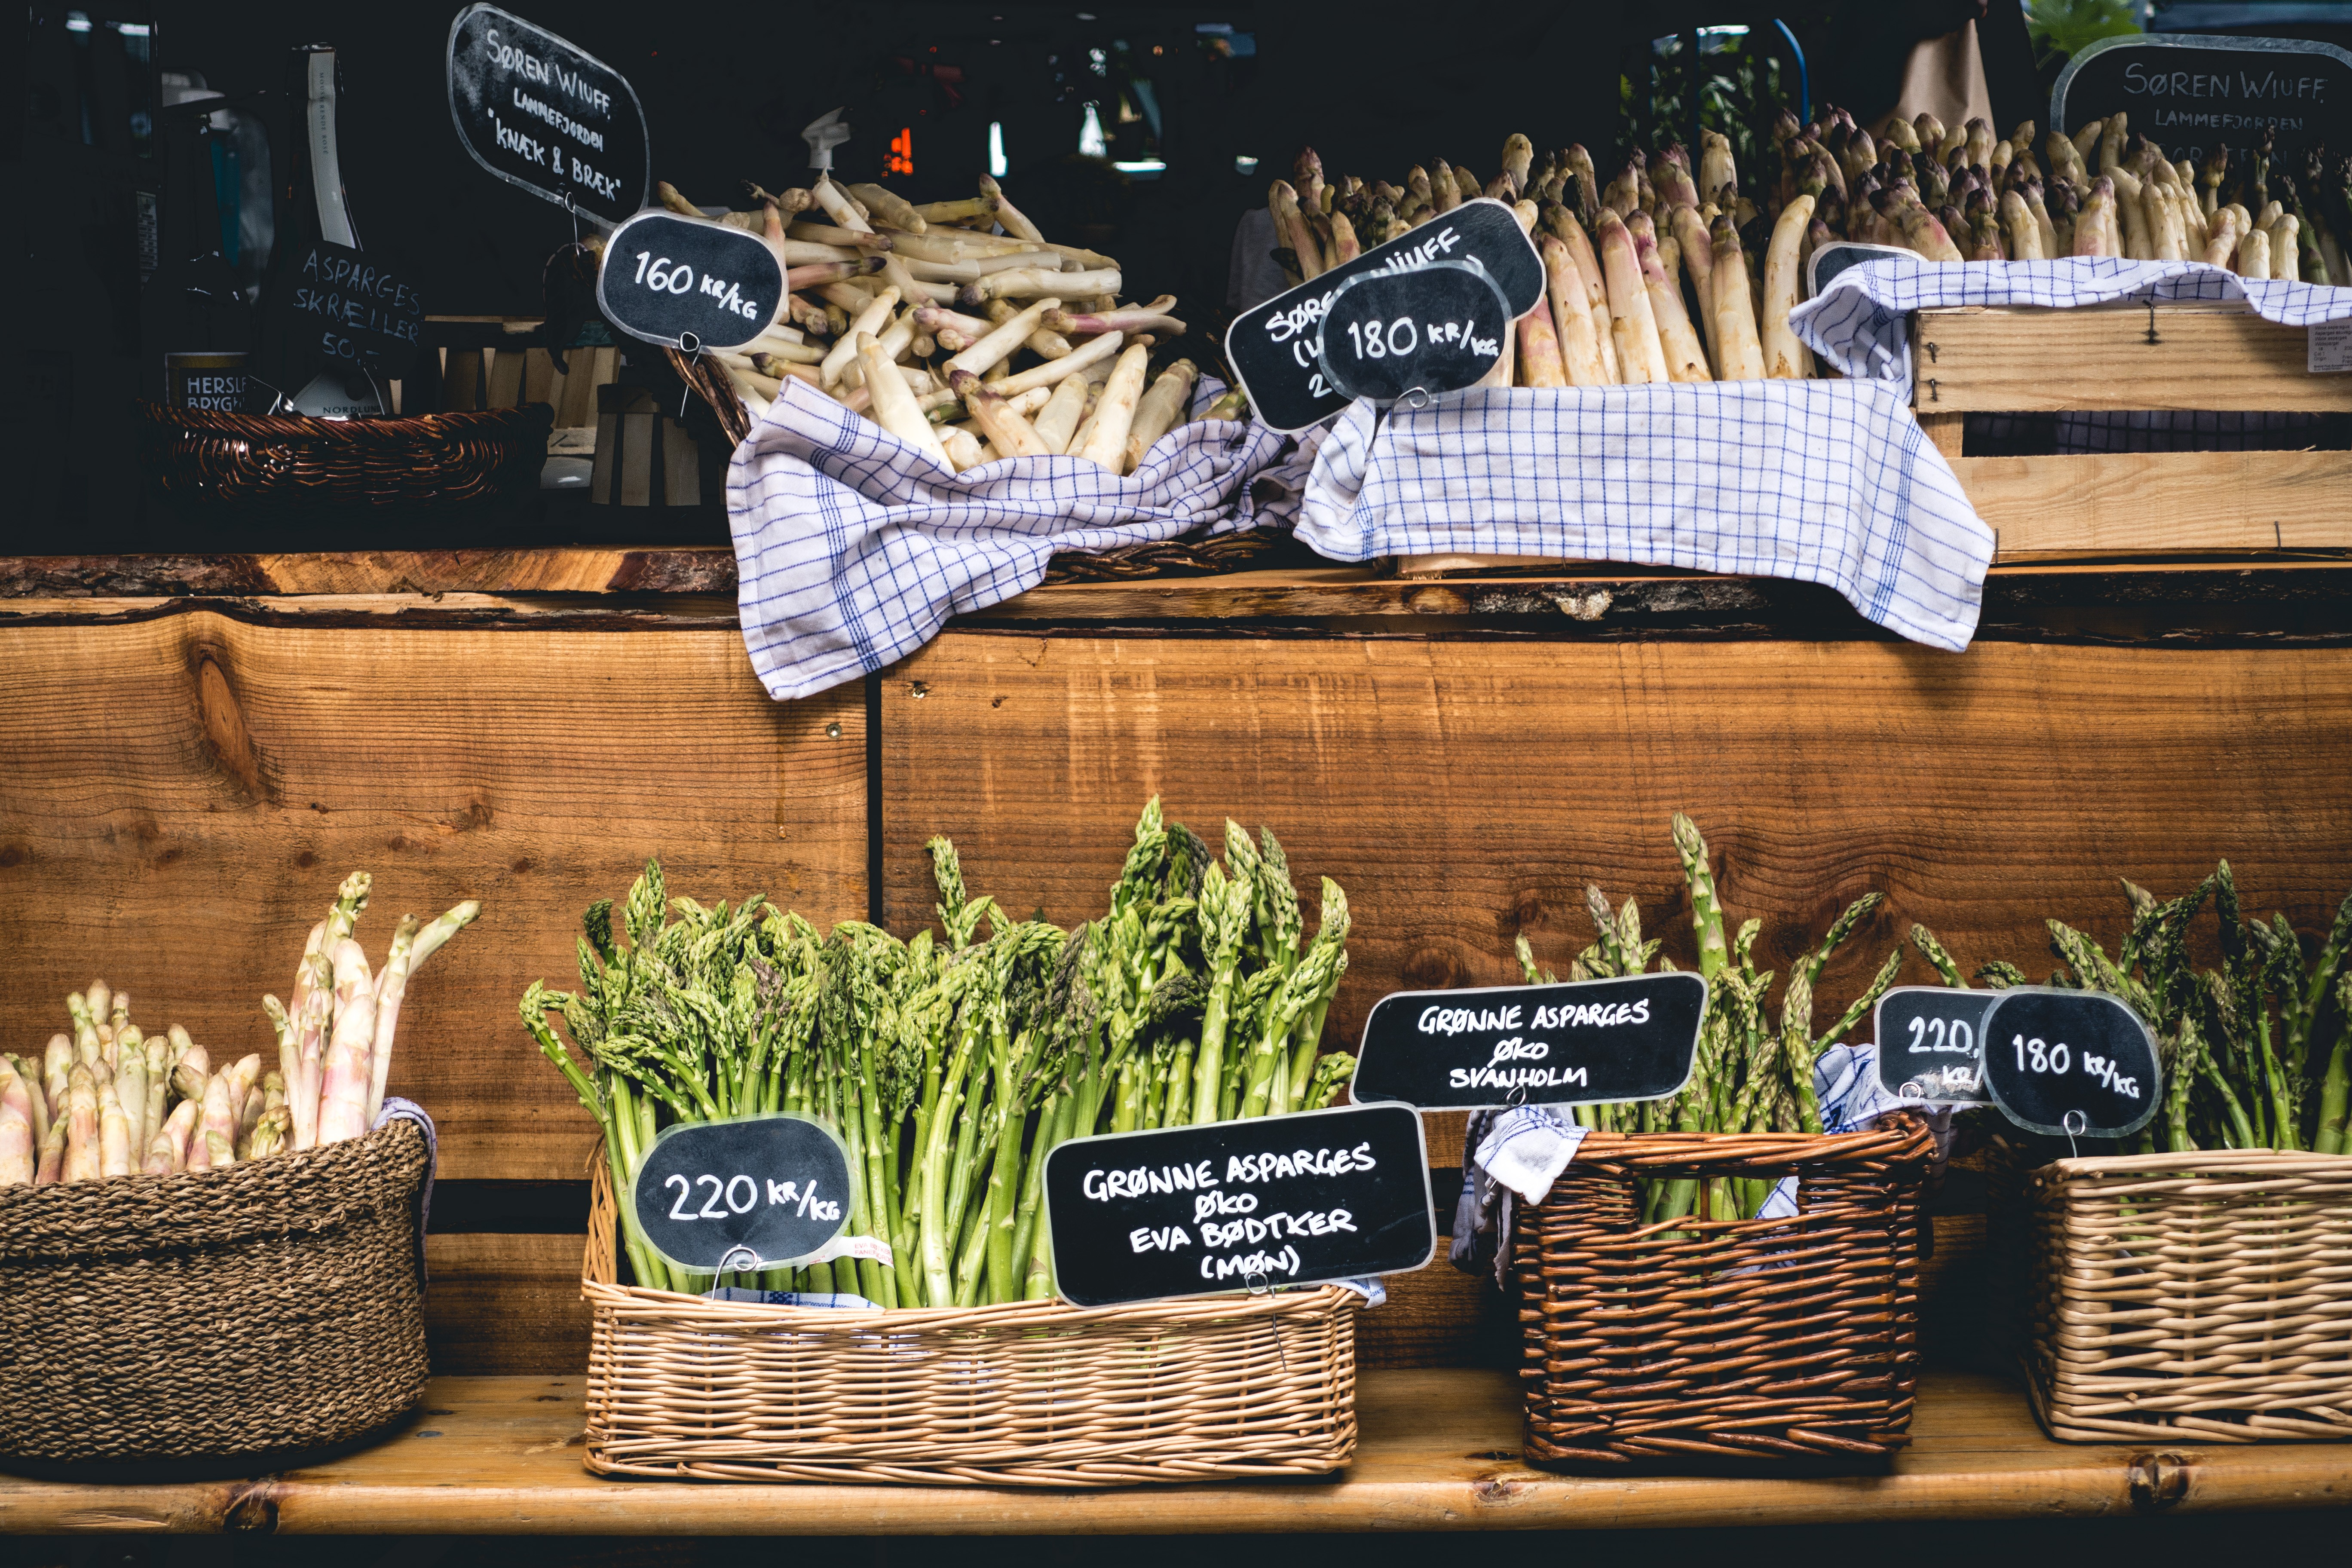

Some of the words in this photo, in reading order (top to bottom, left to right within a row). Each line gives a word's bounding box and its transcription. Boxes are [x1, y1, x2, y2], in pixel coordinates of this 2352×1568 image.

[487, 29, 549, 85] SØREN
[2123, 62, 2230, 98] SØREN
[514, 87, 603, 152] LAMMEFJORDEN
[2155, 109, 2303, 131] LAMMEFJORDEN
[553, 146, 564, 175] &
[303, 248, 420, 315] ASPARGES
[635, 251, 693, 294] 160
[699, 274, 757, 320] KR/KG
[293, 288, 419, 346] SKRÆLLER
[1265, 290, 1337, 342] SØRE
[1348, 316, 1418, 359] 180
[322, 405, 382, 414] NORDLUND
[1418, 1004, 1522, 1037] GRØNNE
[1530, 998, 1650, 1031] ASPARGES
[1488, 1037, 1549, 1069] ØKO
[2012, 1034, 2070, 1075] 180
[1449, 1066, 1587, 1089] SVANHOLM
[1083, 1159, 1219, 1203] GRØNNE
[1225, 1141, 1376, 1183] ASPARGES
[665, 1173, 758, 1220] 220
[766, 1178, 840, 1221] KR/KG
[1193, 1190, 1258, 1225] ØKO
[1129, 1225, 1191, 1254] EVA
[1201, 1208, 1358, 1249] BØDTKER
[1200, 1244, 1301, 1280] (MØN)
